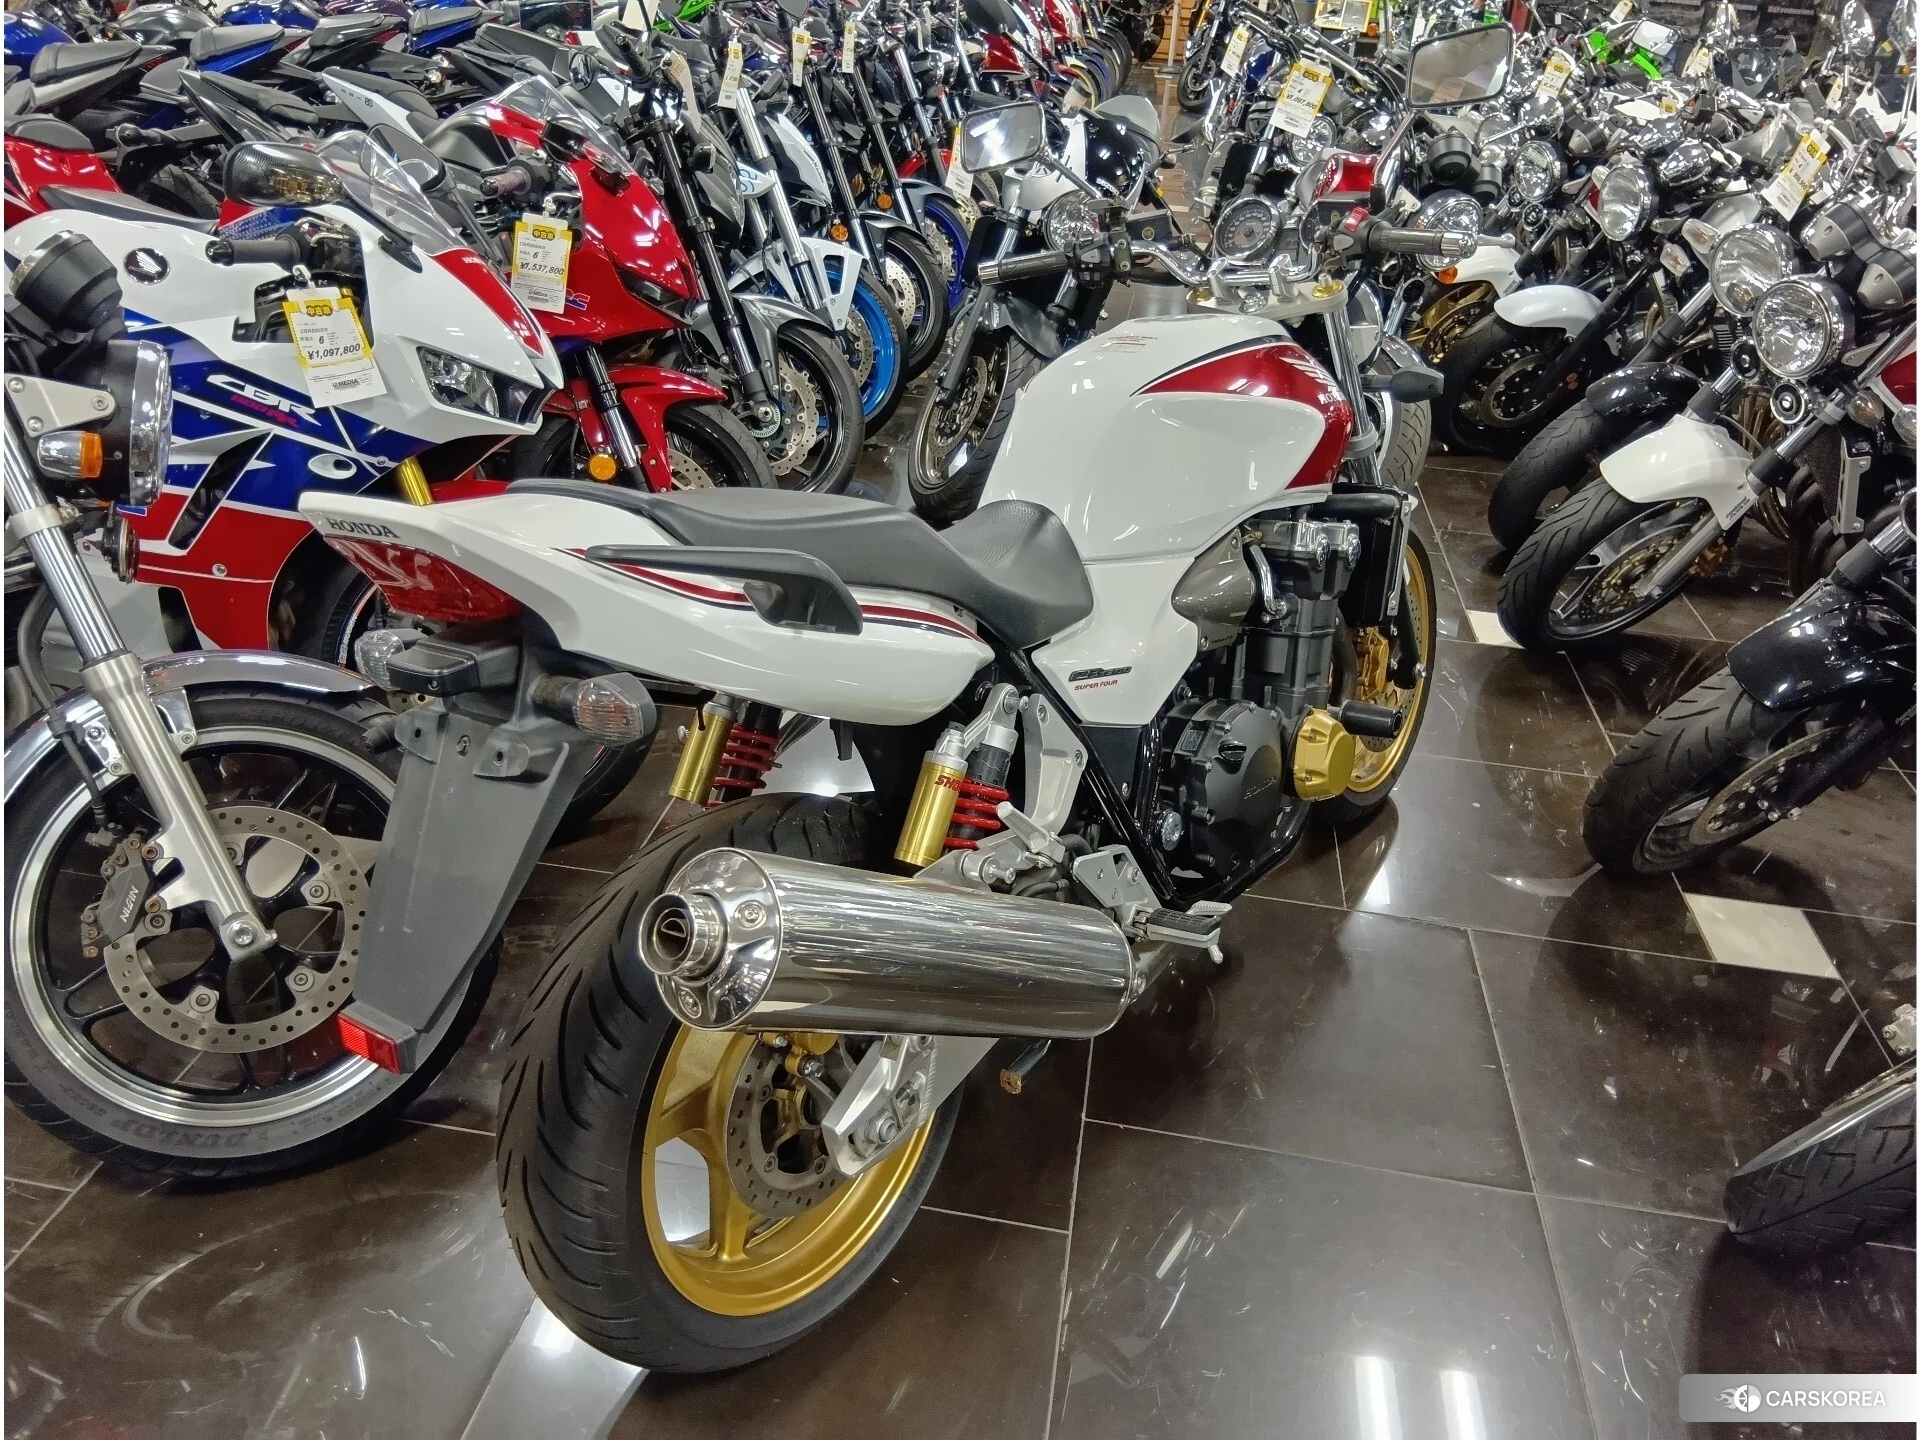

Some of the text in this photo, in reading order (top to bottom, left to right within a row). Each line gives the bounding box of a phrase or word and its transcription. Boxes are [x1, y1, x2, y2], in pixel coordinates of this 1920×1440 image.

[532, 251, 540, 259] 6
[519, 261, 565, 276] ¥1,537,800
[318, 335, 325, 345] 6
[307, 343, 361, 361] ¥1,097,800
[206, 374, 323, 427] CBR
[325, 517, 402, 540] HONDA
[1074, 680, 1118, 691] SUPER FOUR
